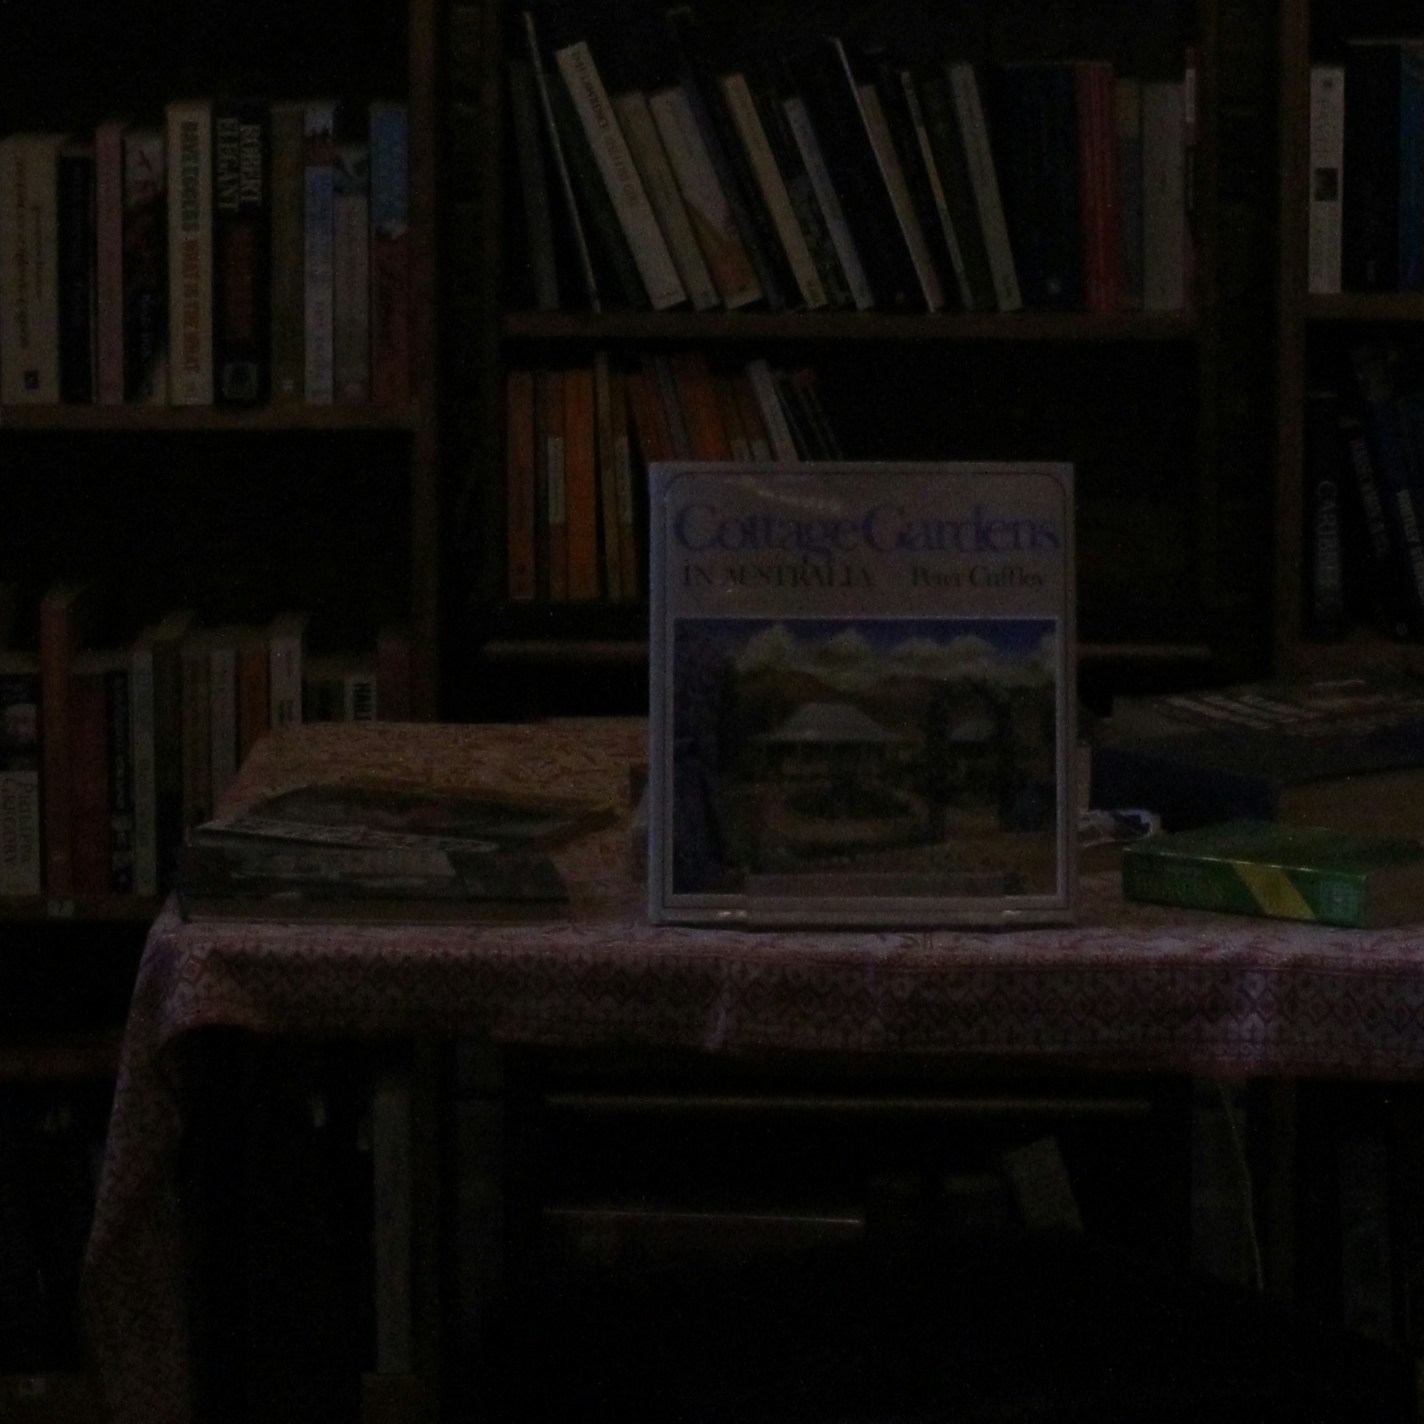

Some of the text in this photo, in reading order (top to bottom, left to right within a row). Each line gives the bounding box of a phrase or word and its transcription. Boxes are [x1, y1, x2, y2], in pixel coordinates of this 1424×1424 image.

[181, 121, 201, 165] DAVE
[215, 117, 241, 214] ELEGANT
[239, 123, 263, 208] ROBERT
[180, 167, 201, 232] EGGERS
[181, 239, 201, 277] WHAT
[181, 298, 200, 328] THE
[181, 332, 200, 373] WHAT
[674, 503, 1059, 566] Cottage Gardens
[683, 556, 874, 588] IN AUSTRALIA
[912, 564, 961, 588] Peter
[0, 777, 19, 866] GREGORY
